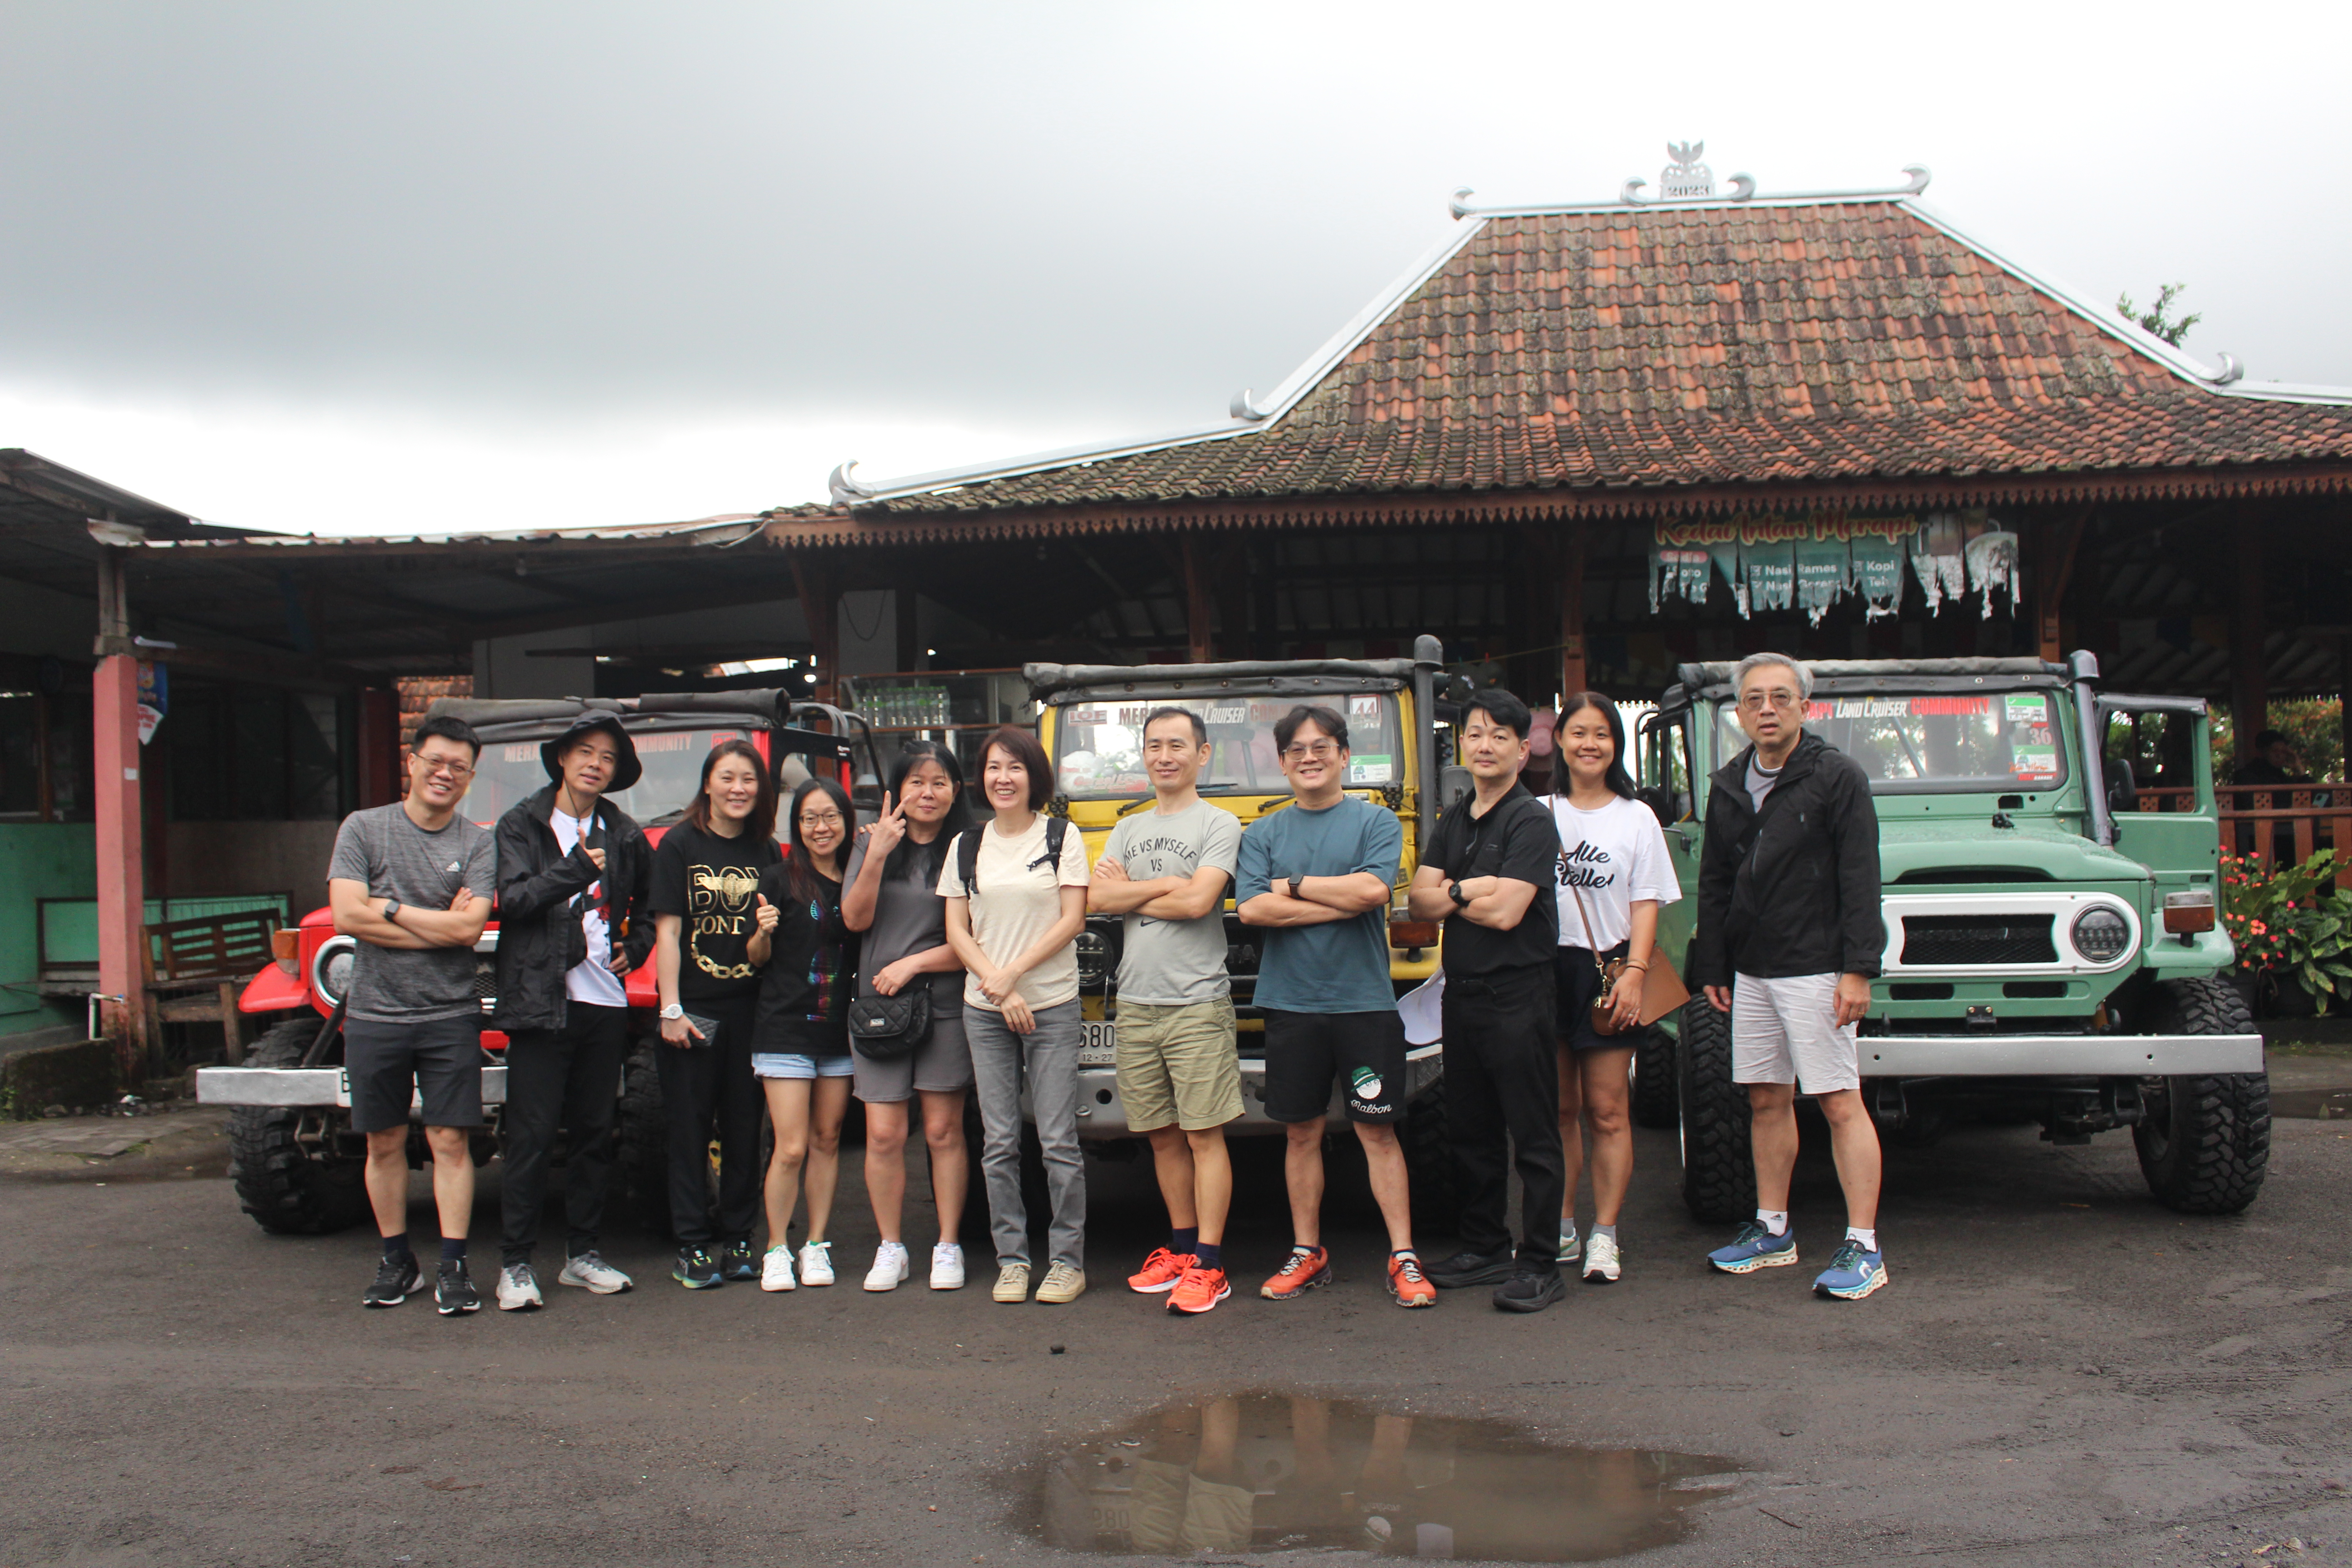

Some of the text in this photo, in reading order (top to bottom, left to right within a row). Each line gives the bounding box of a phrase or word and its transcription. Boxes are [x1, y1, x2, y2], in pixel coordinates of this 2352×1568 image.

[1668, 185, 1710, 197] 2023
[1656, 508, 1919, 547] Kedai Intan Merapi
[1764, 564, 1838, 576] Nasi Rames
[1867, 559, 1895, 572] Kopi
[1911, 697, 1990, 715] COMMUNITY
[1069, 710, 1107, 720] IOF
[2029, 727, 2053, 745] 36
[1124, 837, 1197, 864] ME VS MYSELF
[1565, 840, 1611, 863] Alle
[1151, 858, 1162, 872] VS
[1351, 1099, 1392, 1114] Malbon
